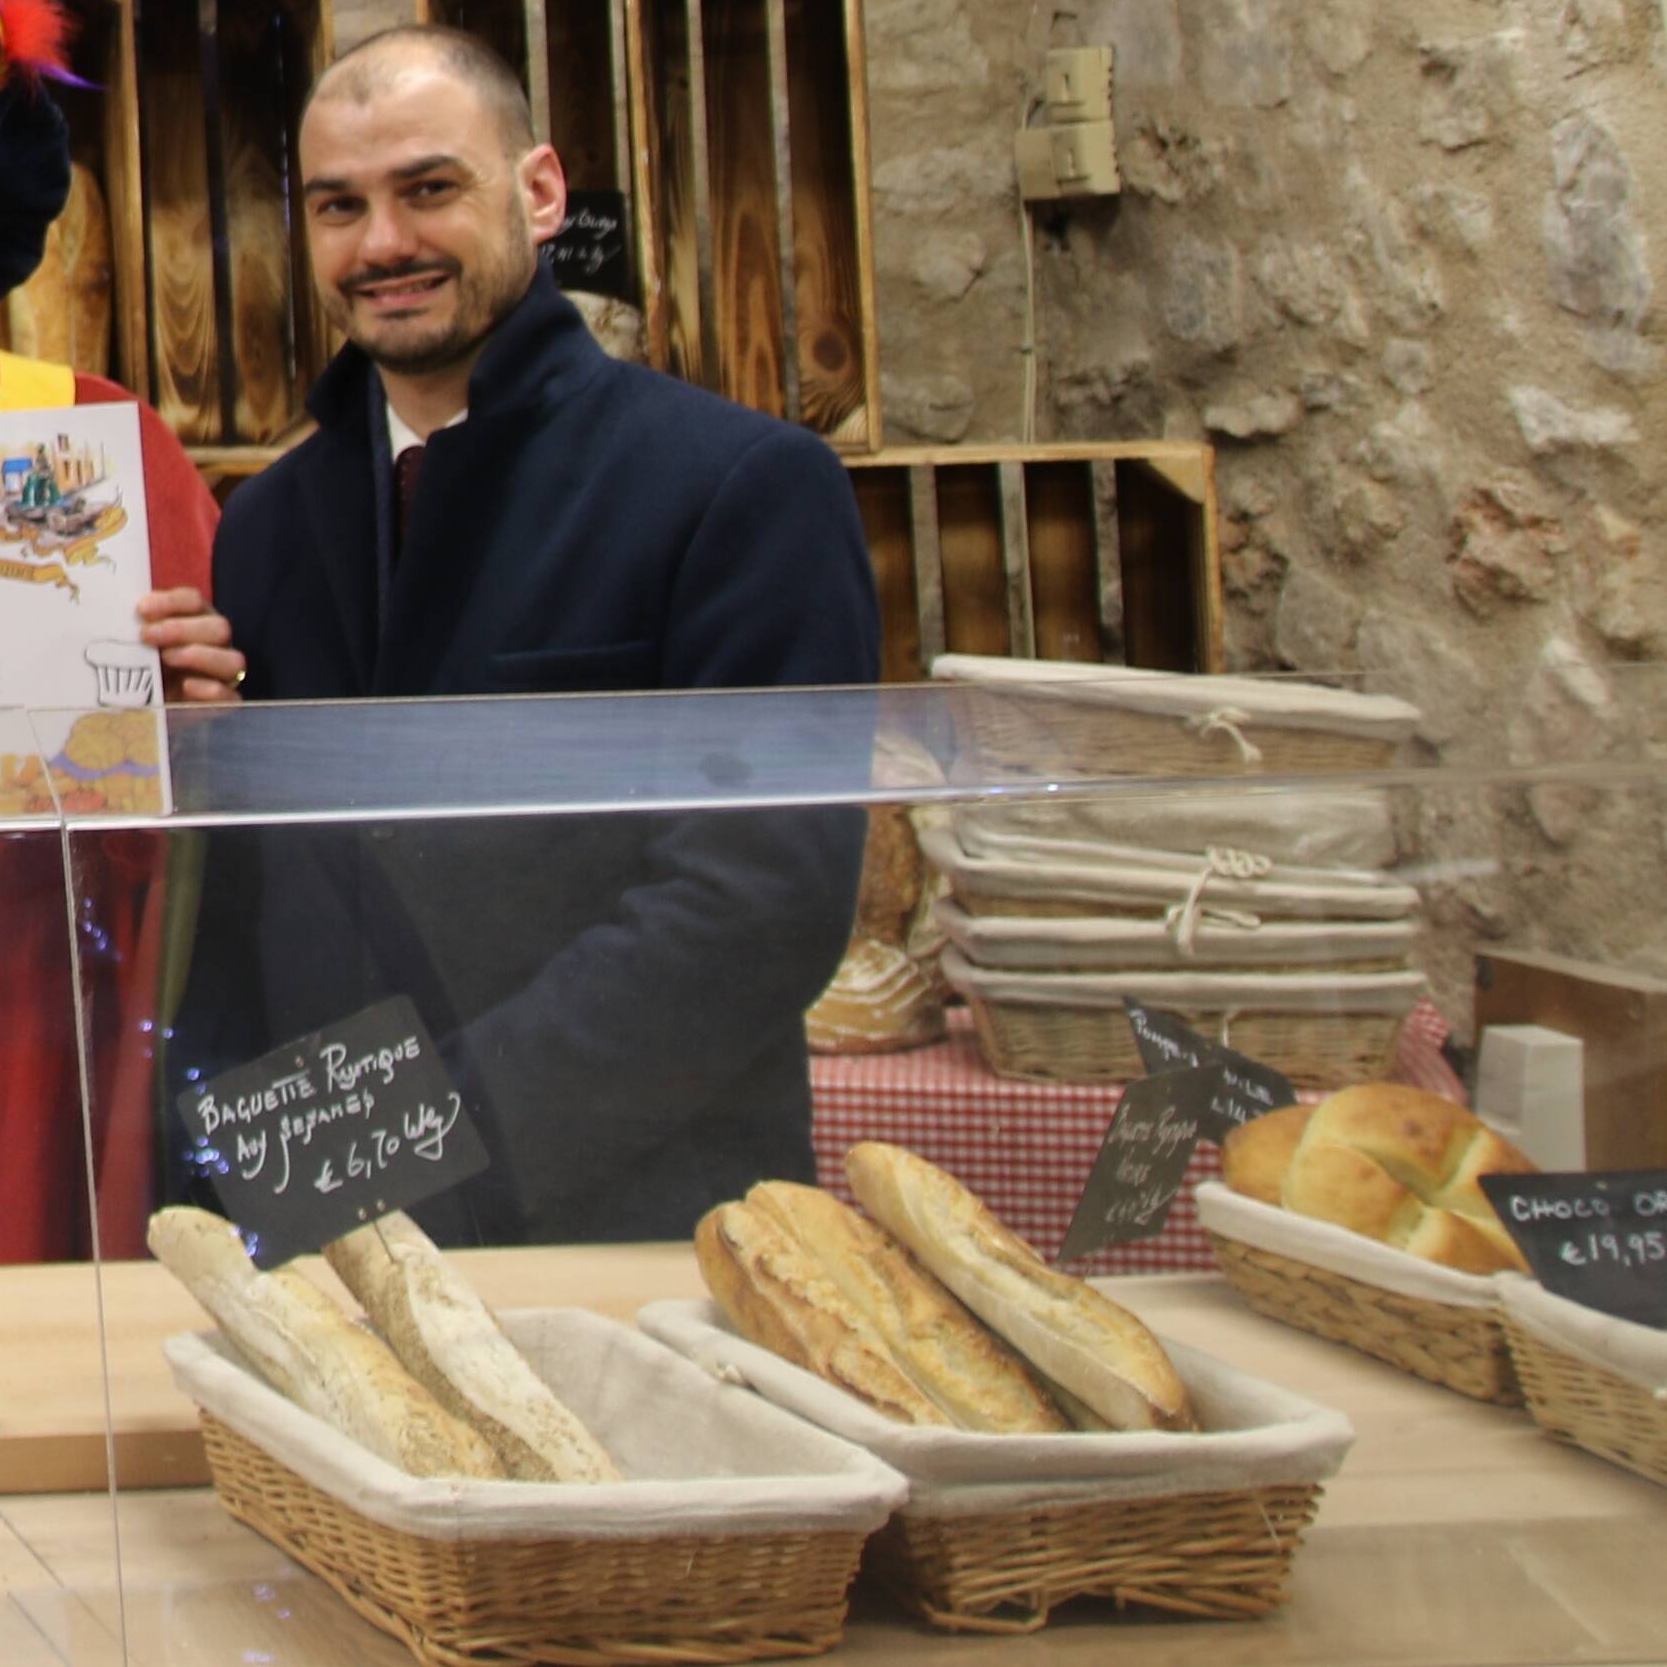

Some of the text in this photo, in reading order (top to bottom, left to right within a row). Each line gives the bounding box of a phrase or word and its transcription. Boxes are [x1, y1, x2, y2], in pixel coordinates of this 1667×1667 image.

[196, 1036, 421, 1135] BAGUETTE RUSTIQUE
[1510, 1194, 1610, 1222] CHOCO
